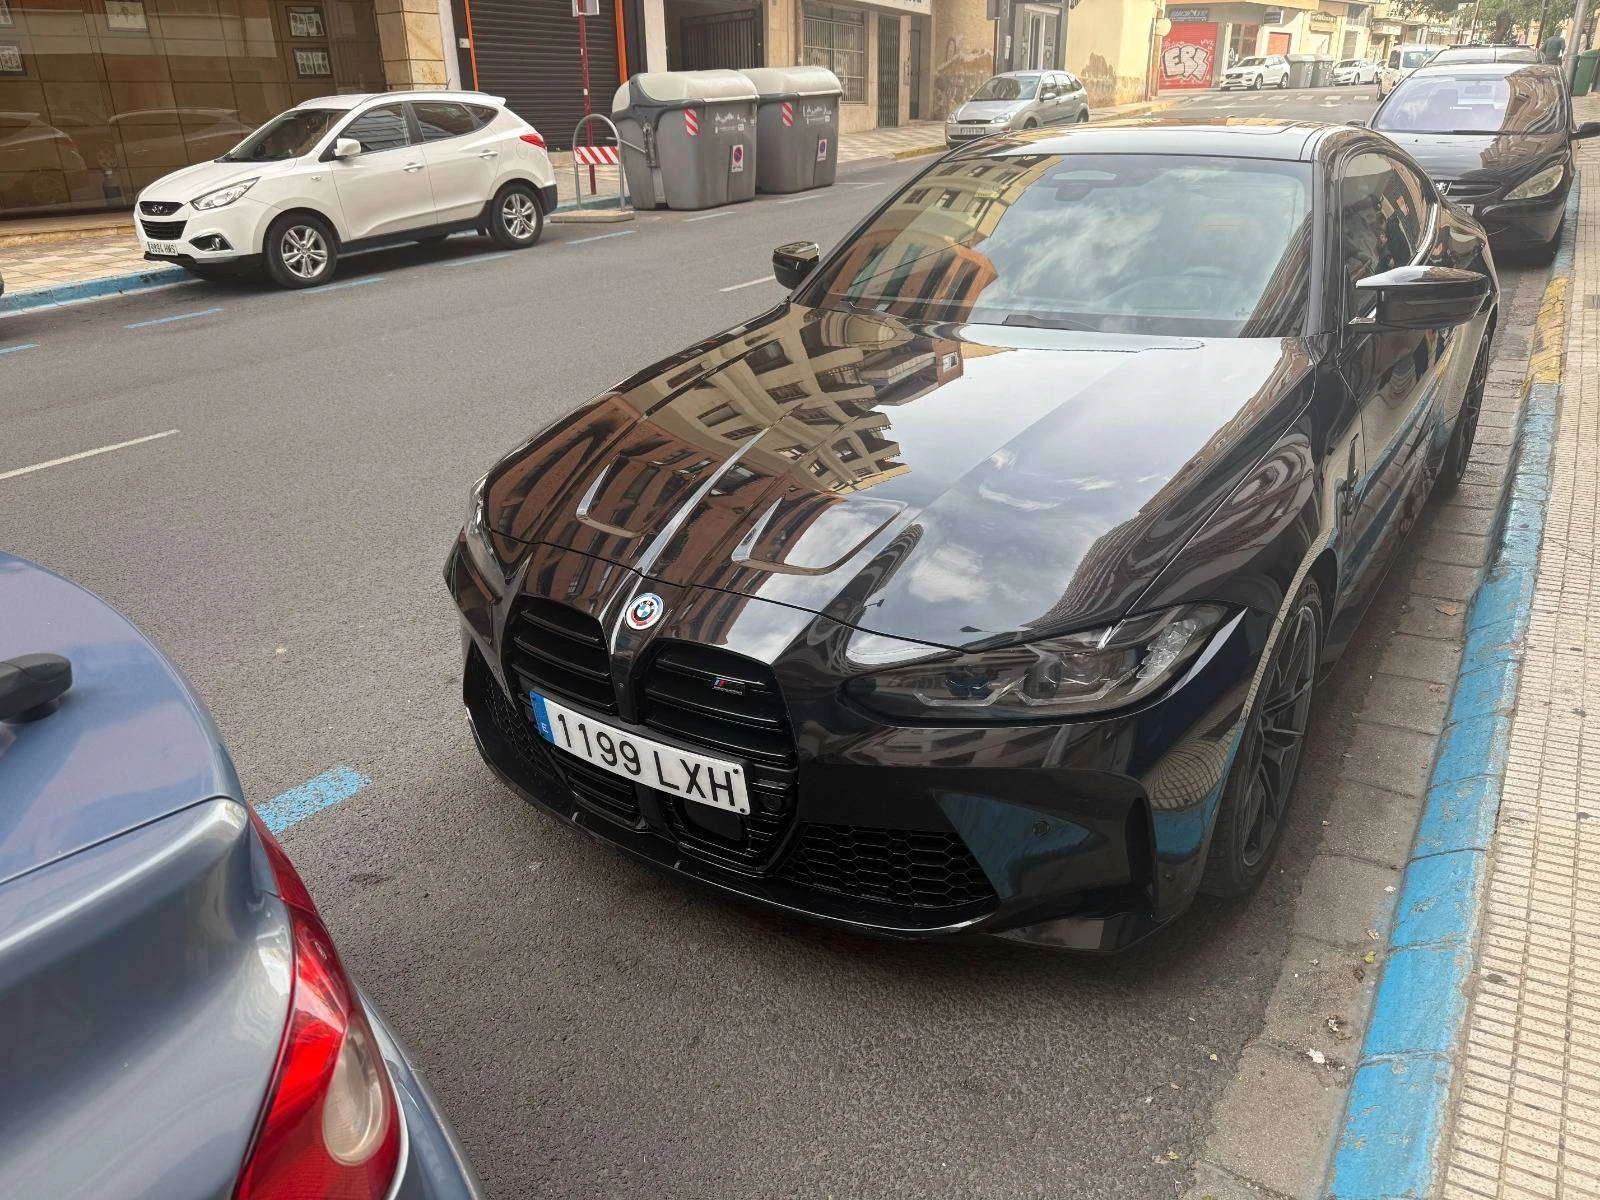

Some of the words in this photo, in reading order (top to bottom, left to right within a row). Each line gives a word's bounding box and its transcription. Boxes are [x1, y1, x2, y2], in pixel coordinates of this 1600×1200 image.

[541, 722, 549, 733] E
[557, 713, 641, 776] 1199
[653, 750, 736, 807] LXH
